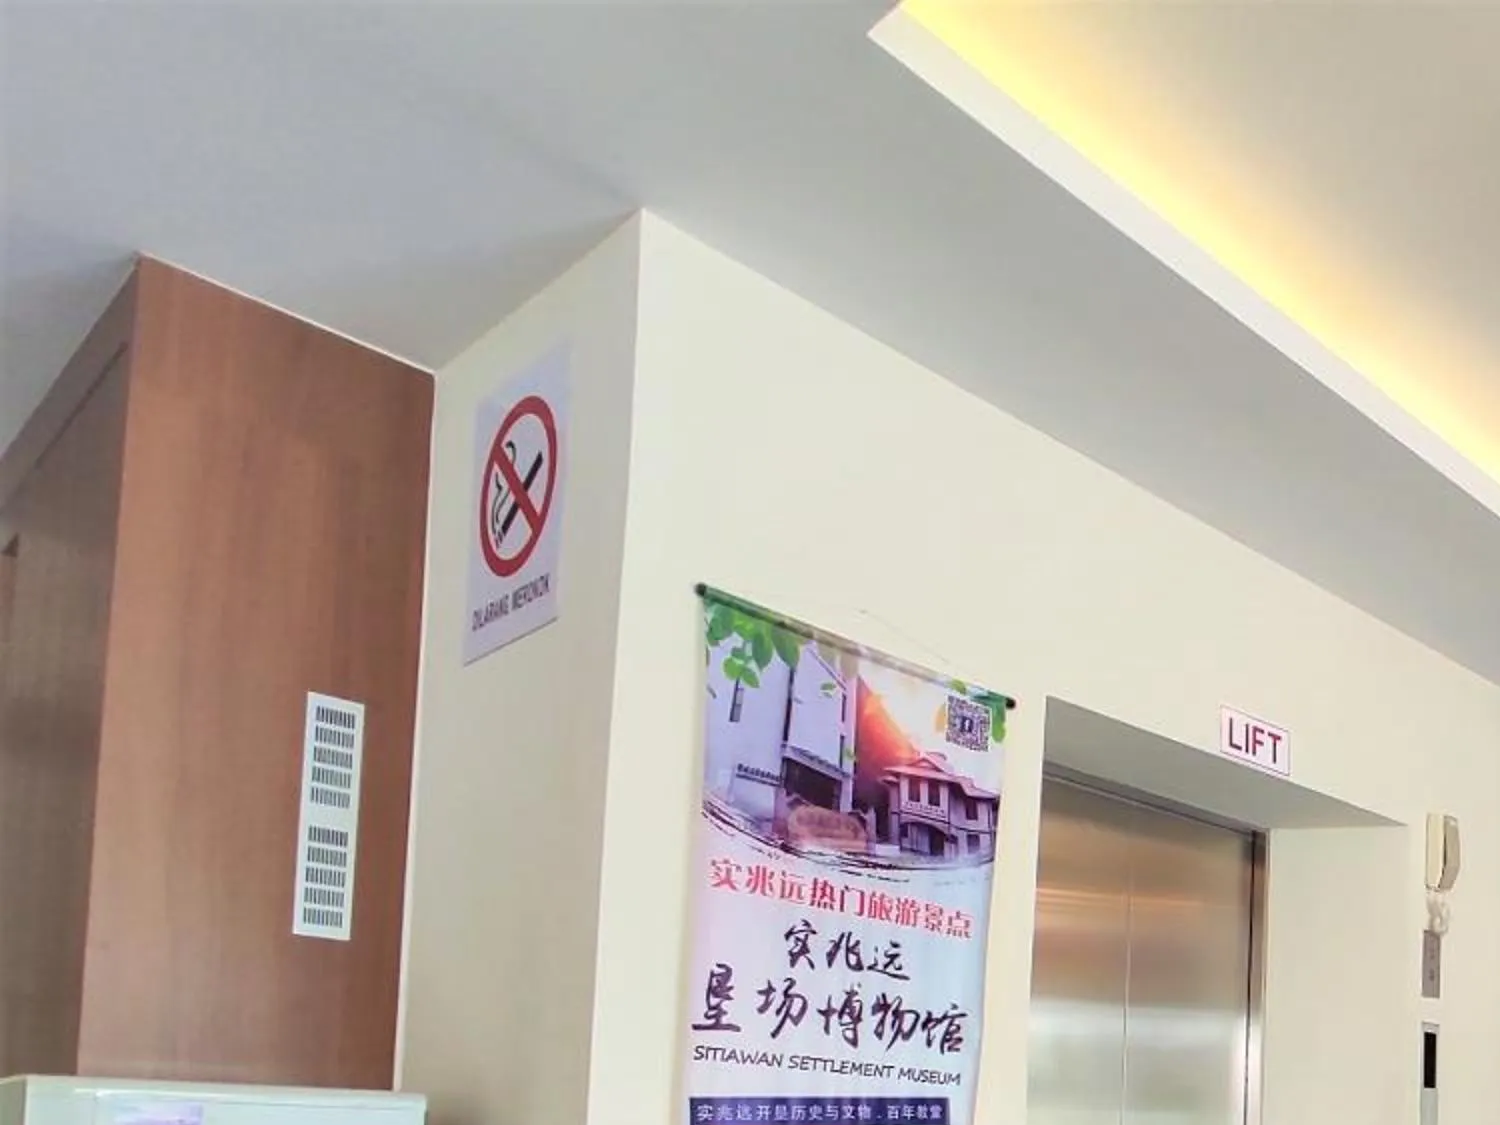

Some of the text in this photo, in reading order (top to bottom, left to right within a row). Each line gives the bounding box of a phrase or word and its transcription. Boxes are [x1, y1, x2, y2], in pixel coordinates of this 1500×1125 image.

[1228, 717, 1283, 764] LIFT
[710, 859, 975, 939] 实兆远热门旅游景点
[693, 1045, 961, 1086] SITIAWAN SETTLEMENT MUSEUM
